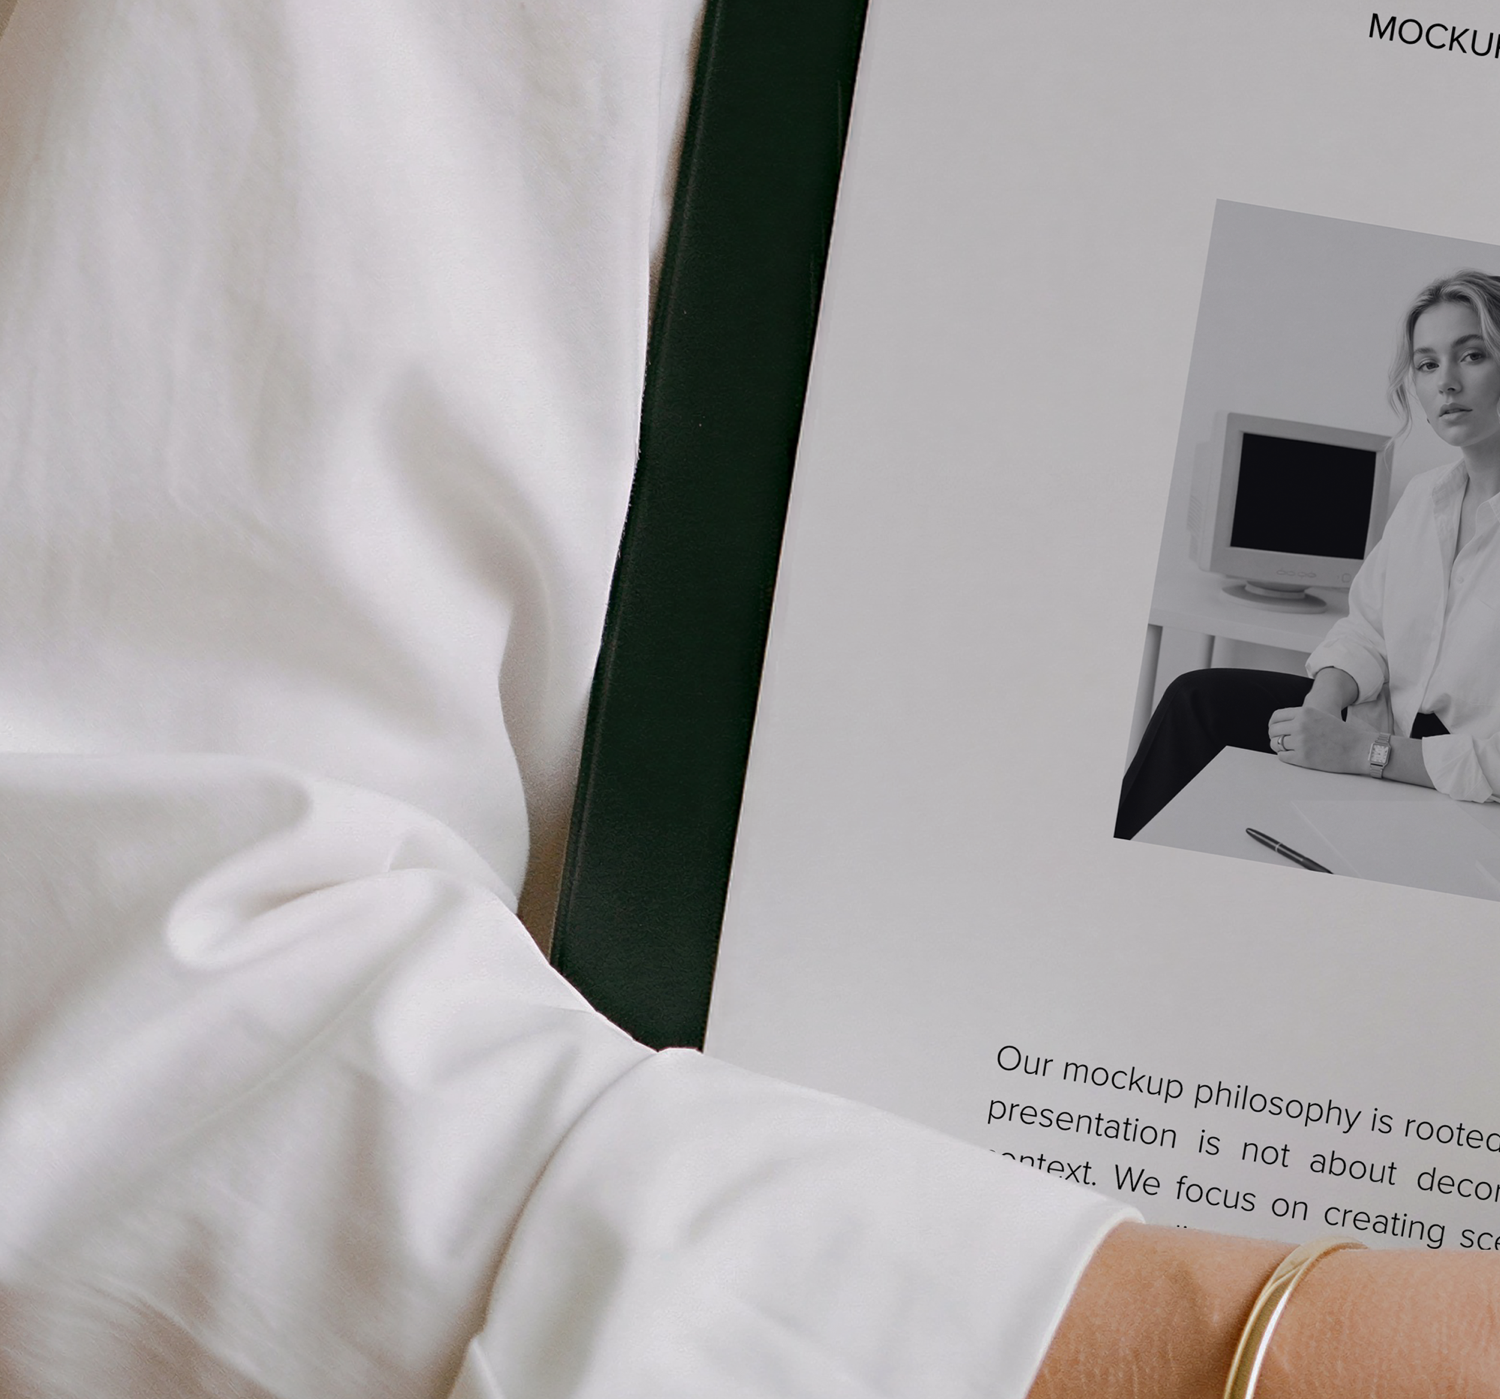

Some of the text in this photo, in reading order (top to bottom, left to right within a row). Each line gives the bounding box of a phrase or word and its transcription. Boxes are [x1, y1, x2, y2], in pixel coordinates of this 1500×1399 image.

[997, 1045, 1054, 1077] Our
[1063, 1061, 1184, 1104] mockup
[1194, 1080, 1362, 1134] philosophy
[1371, 1107, 1394, 1134] is
[987, 1099, 1177, 1149] presentation
[1198, 1129, 1221, 1156] is
[1241, 1142, 1291, 1168] not
[1309, 1150, 1398, 1186] about
[1114, 1164, 1161, 1196] We
[1176, 1175, 1257, 1212] focus
[1271, 1197, 1308, 1221] on
[1324, 1206, 1446, 1250] creating
